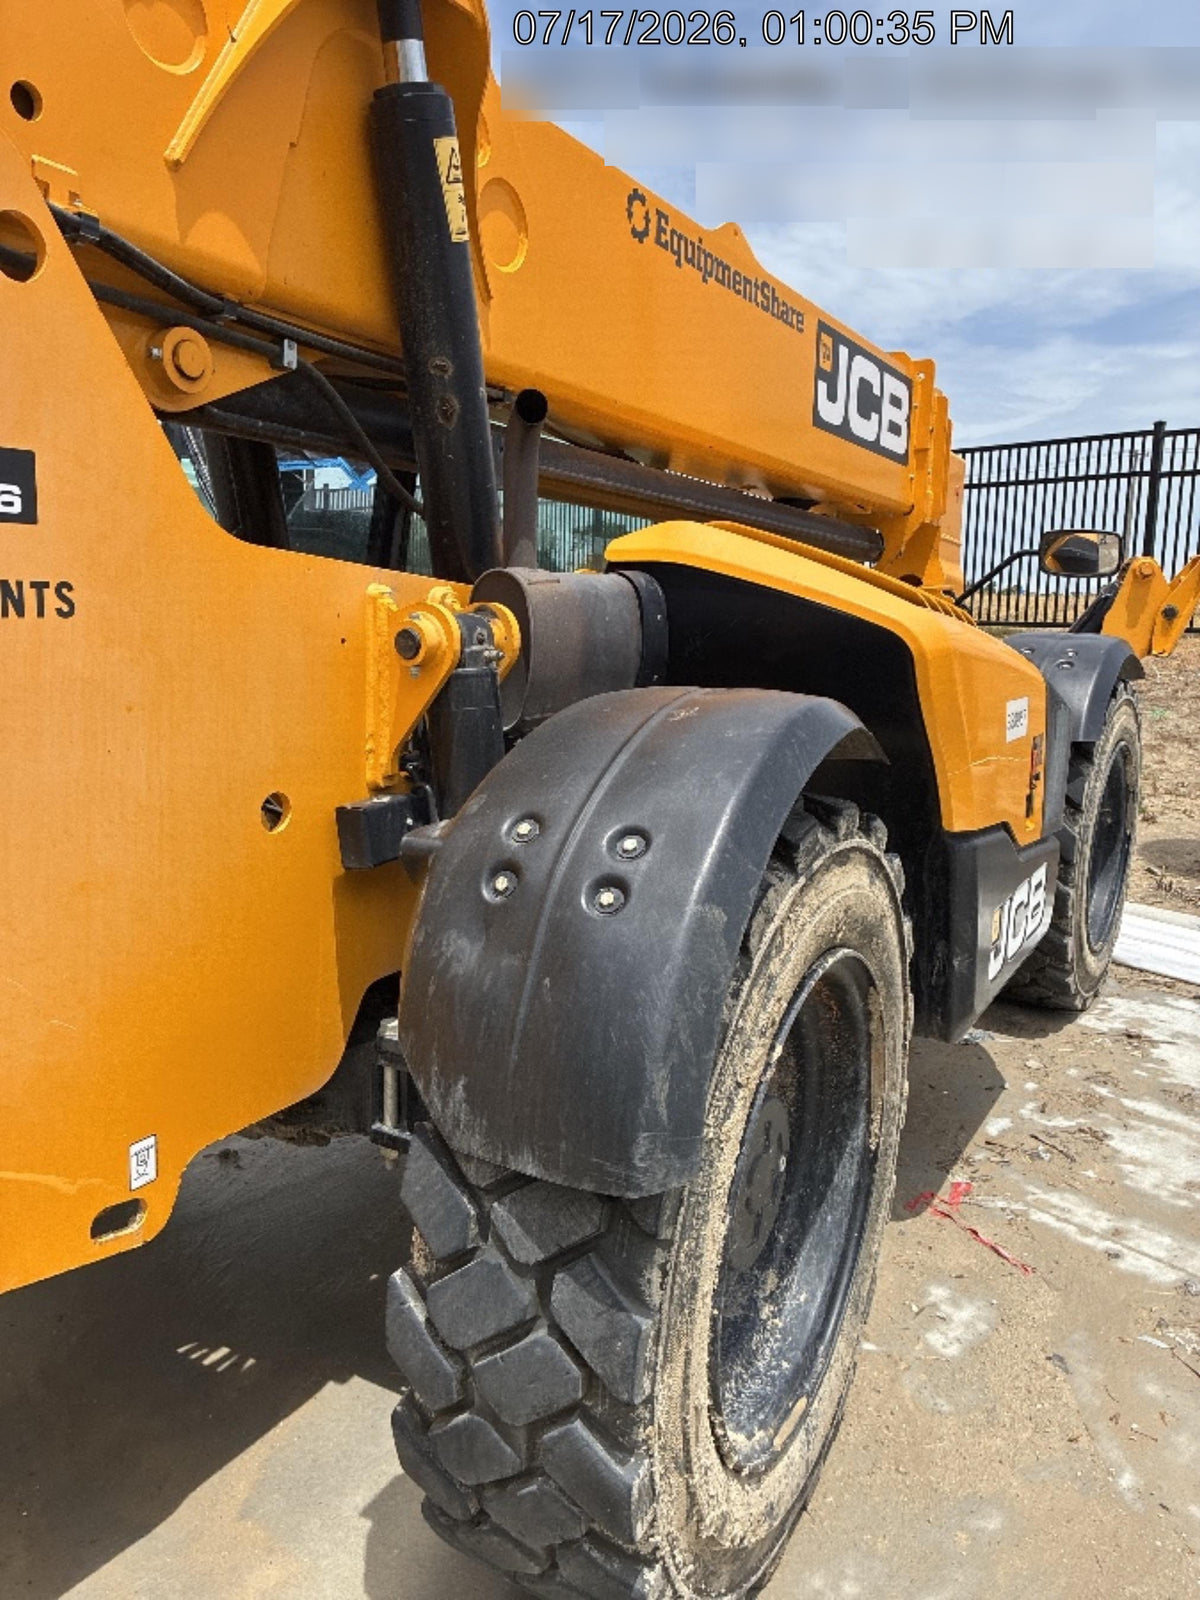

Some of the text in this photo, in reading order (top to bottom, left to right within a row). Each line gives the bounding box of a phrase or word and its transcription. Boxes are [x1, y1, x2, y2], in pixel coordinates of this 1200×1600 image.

[654, 208, 805, 333] EquipmentShare
[817, 344, 910, 455] JCB
[988, 862, 1048, 981] JCB
